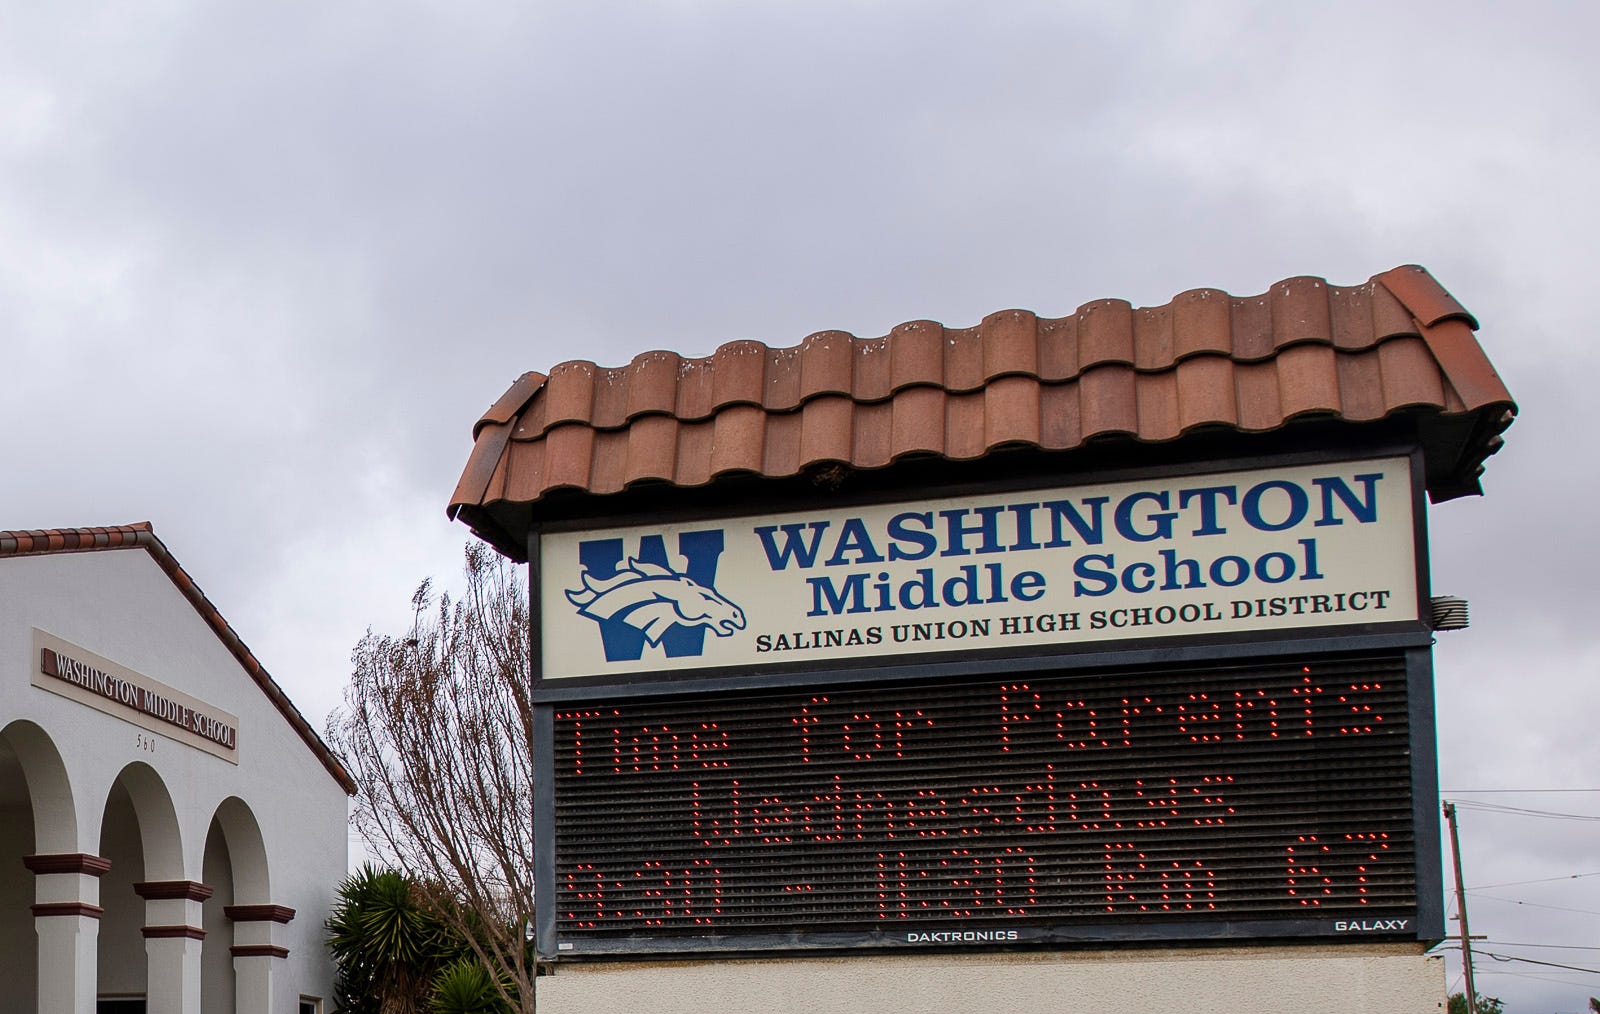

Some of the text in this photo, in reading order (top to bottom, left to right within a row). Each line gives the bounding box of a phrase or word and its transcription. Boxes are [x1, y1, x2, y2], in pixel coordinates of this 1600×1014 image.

[753, 472, 1384, 571] WASHINGTON
[805, 537, 1325, 618] Middle School
[755, 590, 1391, 653] SALINAS UNION HIGH SCHOOL DISTRICT
[55, 652, 234, 747] WASHINGTON MIDDLE SCHOOL
[556, 666, 1384, 776] Time for Parents
[136, 733, 155, 752] 560
[692, 763, 1236, 848] Wednesdays
[1104, 842, 1216, 912] Rm
[1286, 832, 1390, 907] 67
[907, 930, 1019, 942] DAKTRONICS
[1335, 919, 1409, 931] GALAXY
